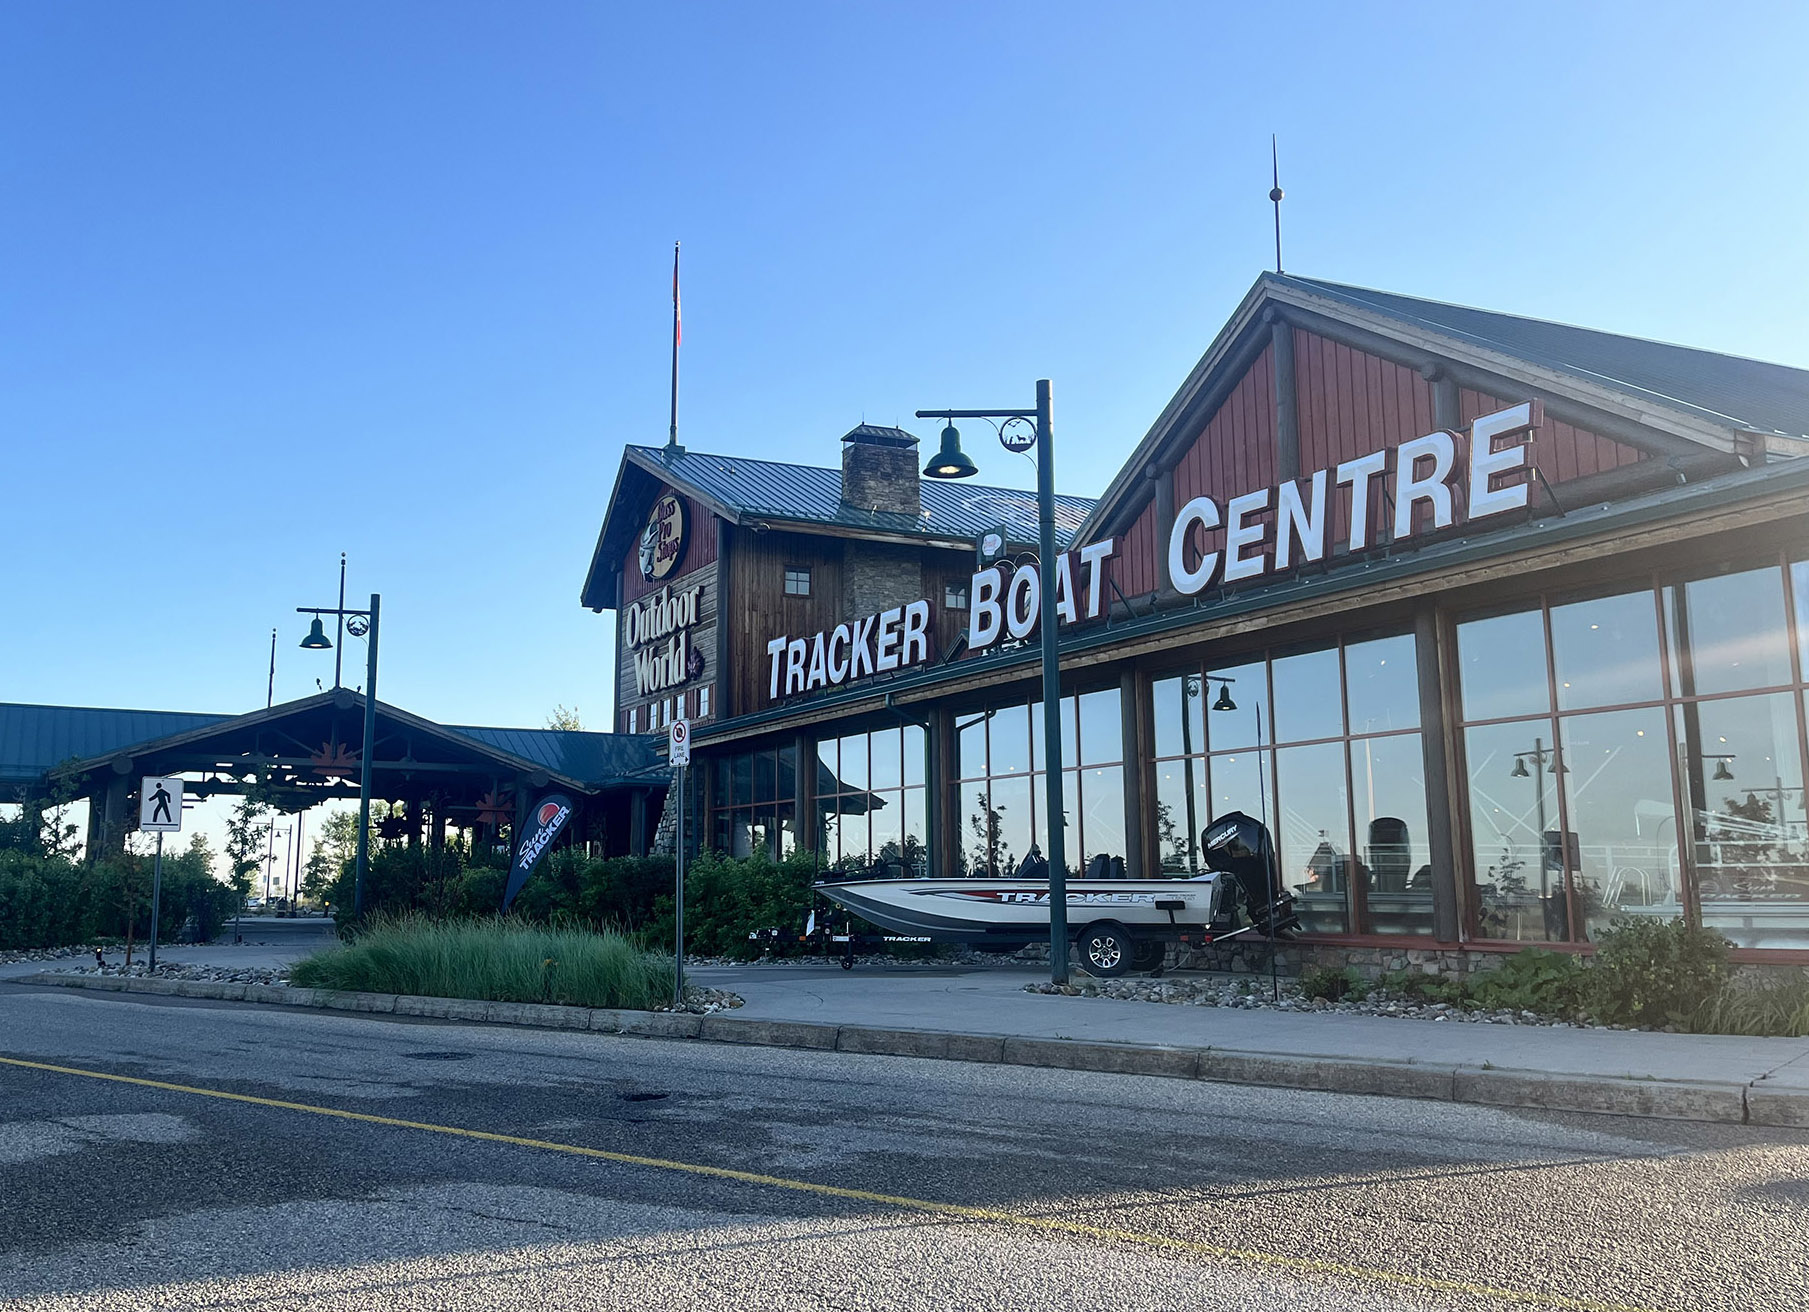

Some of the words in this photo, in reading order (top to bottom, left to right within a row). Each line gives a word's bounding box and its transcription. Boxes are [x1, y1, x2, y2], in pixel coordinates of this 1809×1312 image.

[657, 500, 675, 523] Bass
[658, 521, 671, 542] Pro
[657, 536, 679, 562] Shops
[768, 600, 929, 699] TRACKER
[969, 538, 1113, 649] BOAT
[1168, 401, 1531, 595] CENTRE
[626, 585, 700, 648] Outdoor
[634, 631, 686, 695] World
[519, 806, 571, 870] TRACKER
[519, 828, 544, 862] Sun
[1207, 824, 1238, 849] MERCURY
